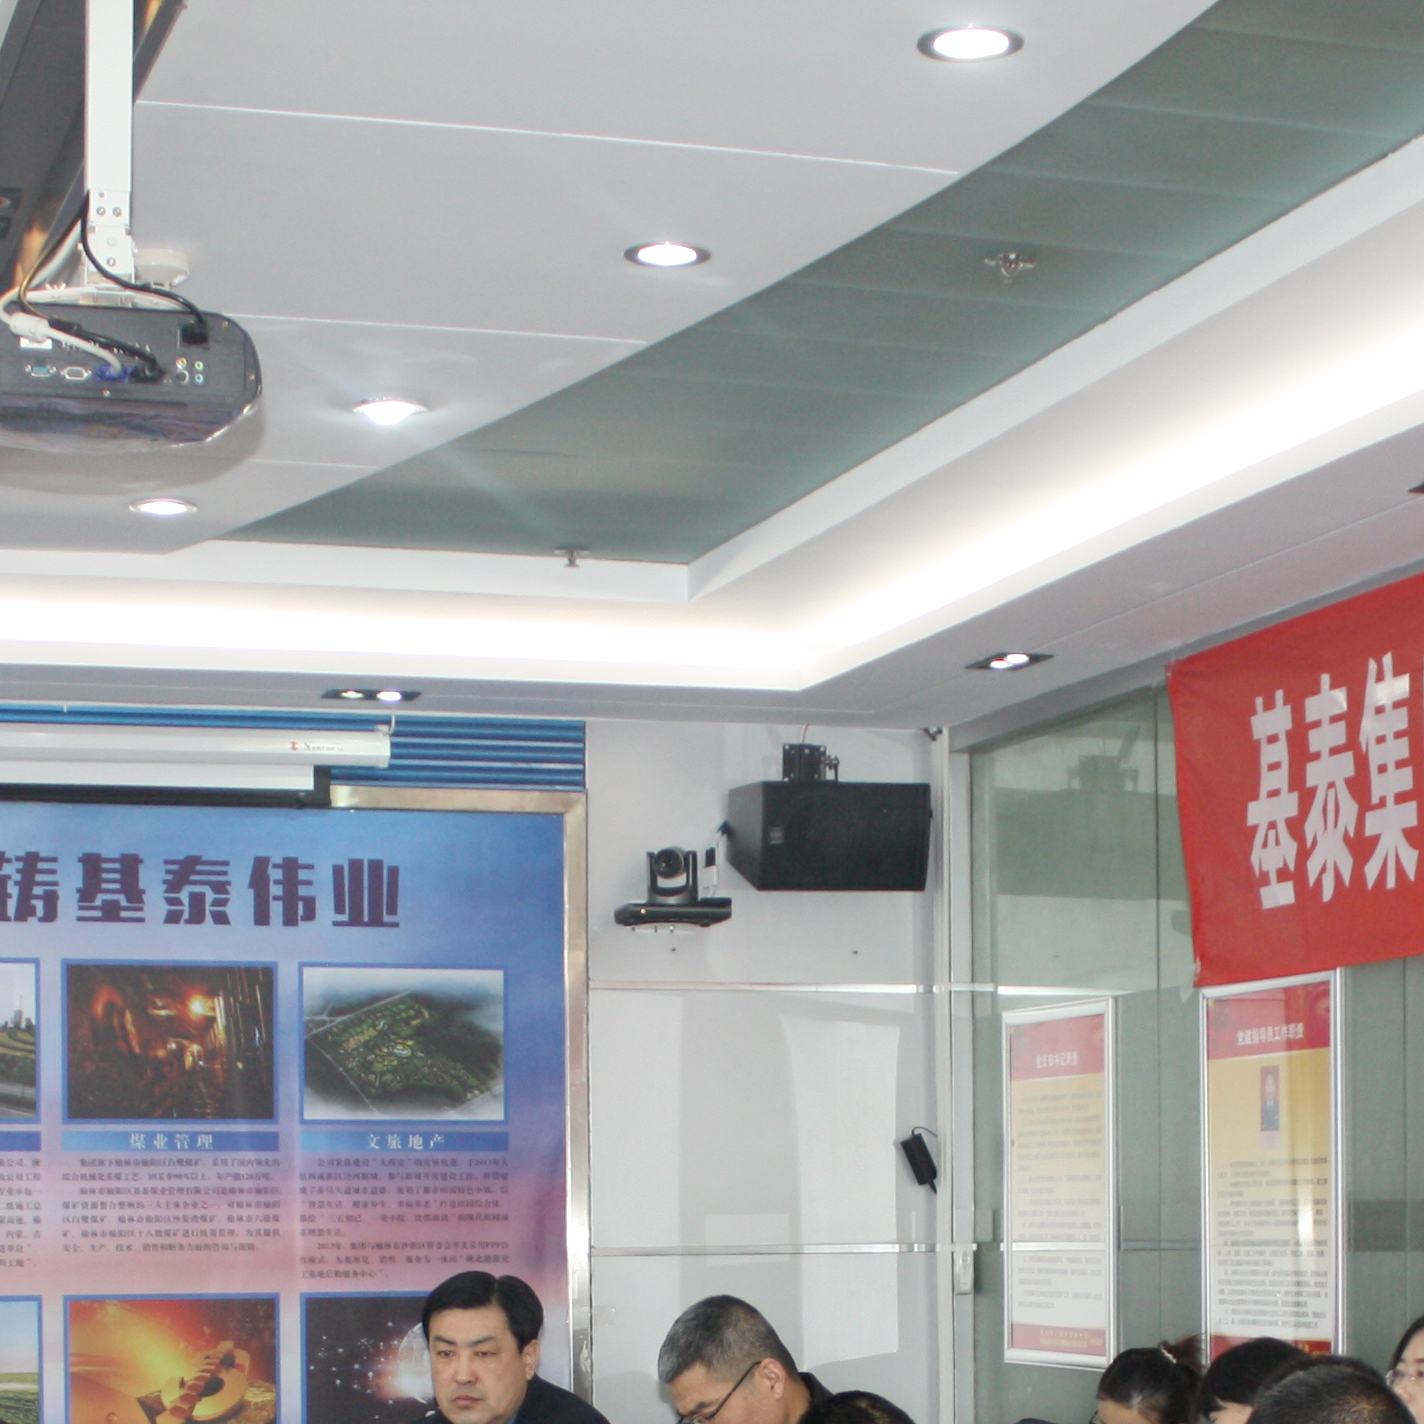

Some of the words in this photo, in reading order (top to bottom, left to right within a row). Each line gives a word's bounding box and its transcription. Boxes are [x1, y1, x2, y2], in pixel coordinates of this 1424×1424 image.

[129, 1133, 213, 1150] 煤业管理
[368, 1133, 445, 1150] 文旅地产
